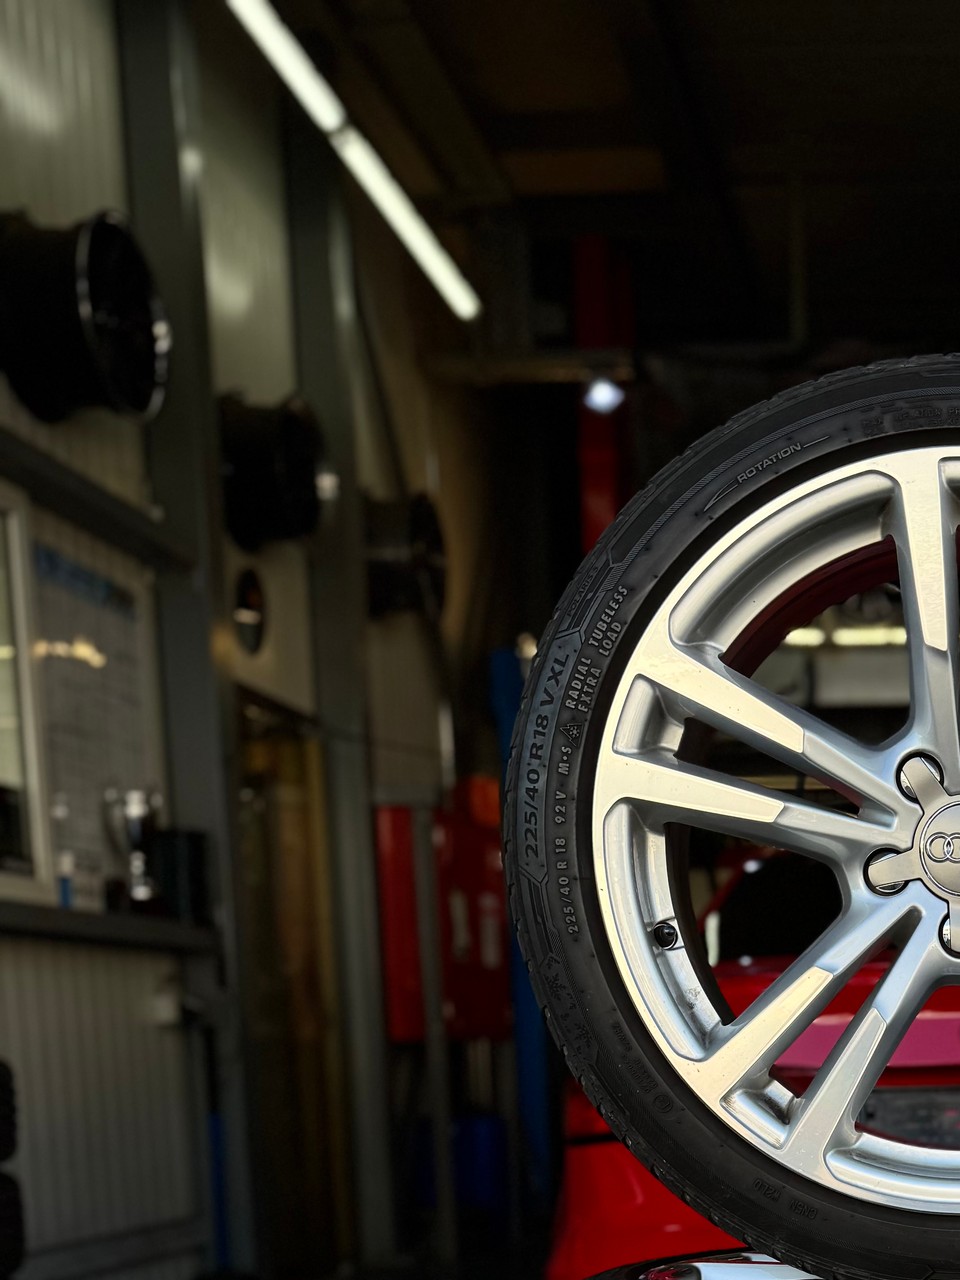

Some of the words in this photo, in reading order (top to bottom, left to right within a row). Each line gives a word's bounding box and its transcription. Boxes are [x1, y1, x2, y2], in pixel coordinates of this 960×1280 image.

[735, 441, 802, 484] ROTATION
[563, 655, 591, 710] RADIAL
[586, 583, 629, 648] TUBELESS
[576, 665, 602, 713] EXTRA
[597, 619, 623, 656] LOAD
[527, 712, 550, 761] R18
[522, 766, 541, 860] 225/40
[557, 875, 578, 935] 225/40
